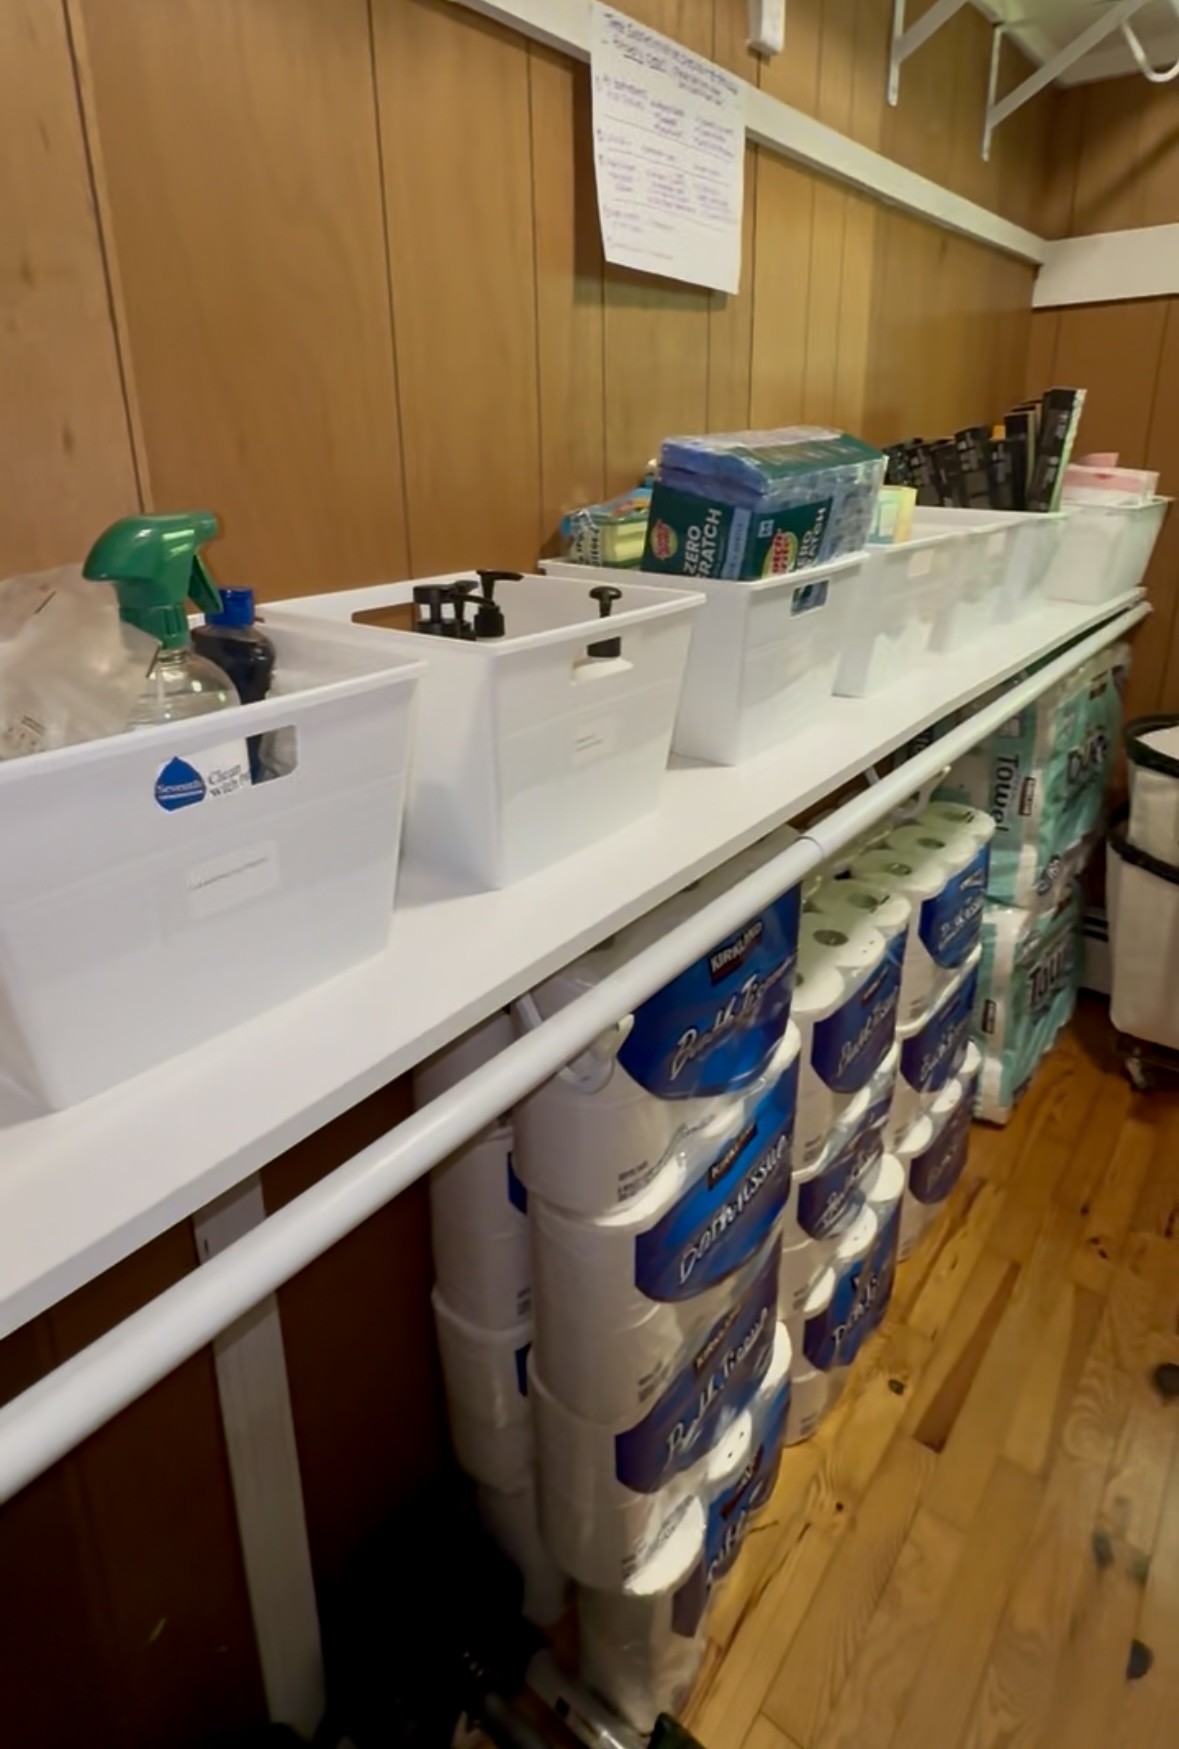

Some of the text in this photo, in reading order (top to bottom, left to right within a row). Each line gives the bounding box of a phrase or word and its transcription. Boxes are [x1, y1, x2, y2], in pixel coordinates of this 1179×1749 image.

[683, 525, 701, 575] ZERO
[699, 508, 722, 577] RATCH
[992, 754, 1020, 832] Towel
